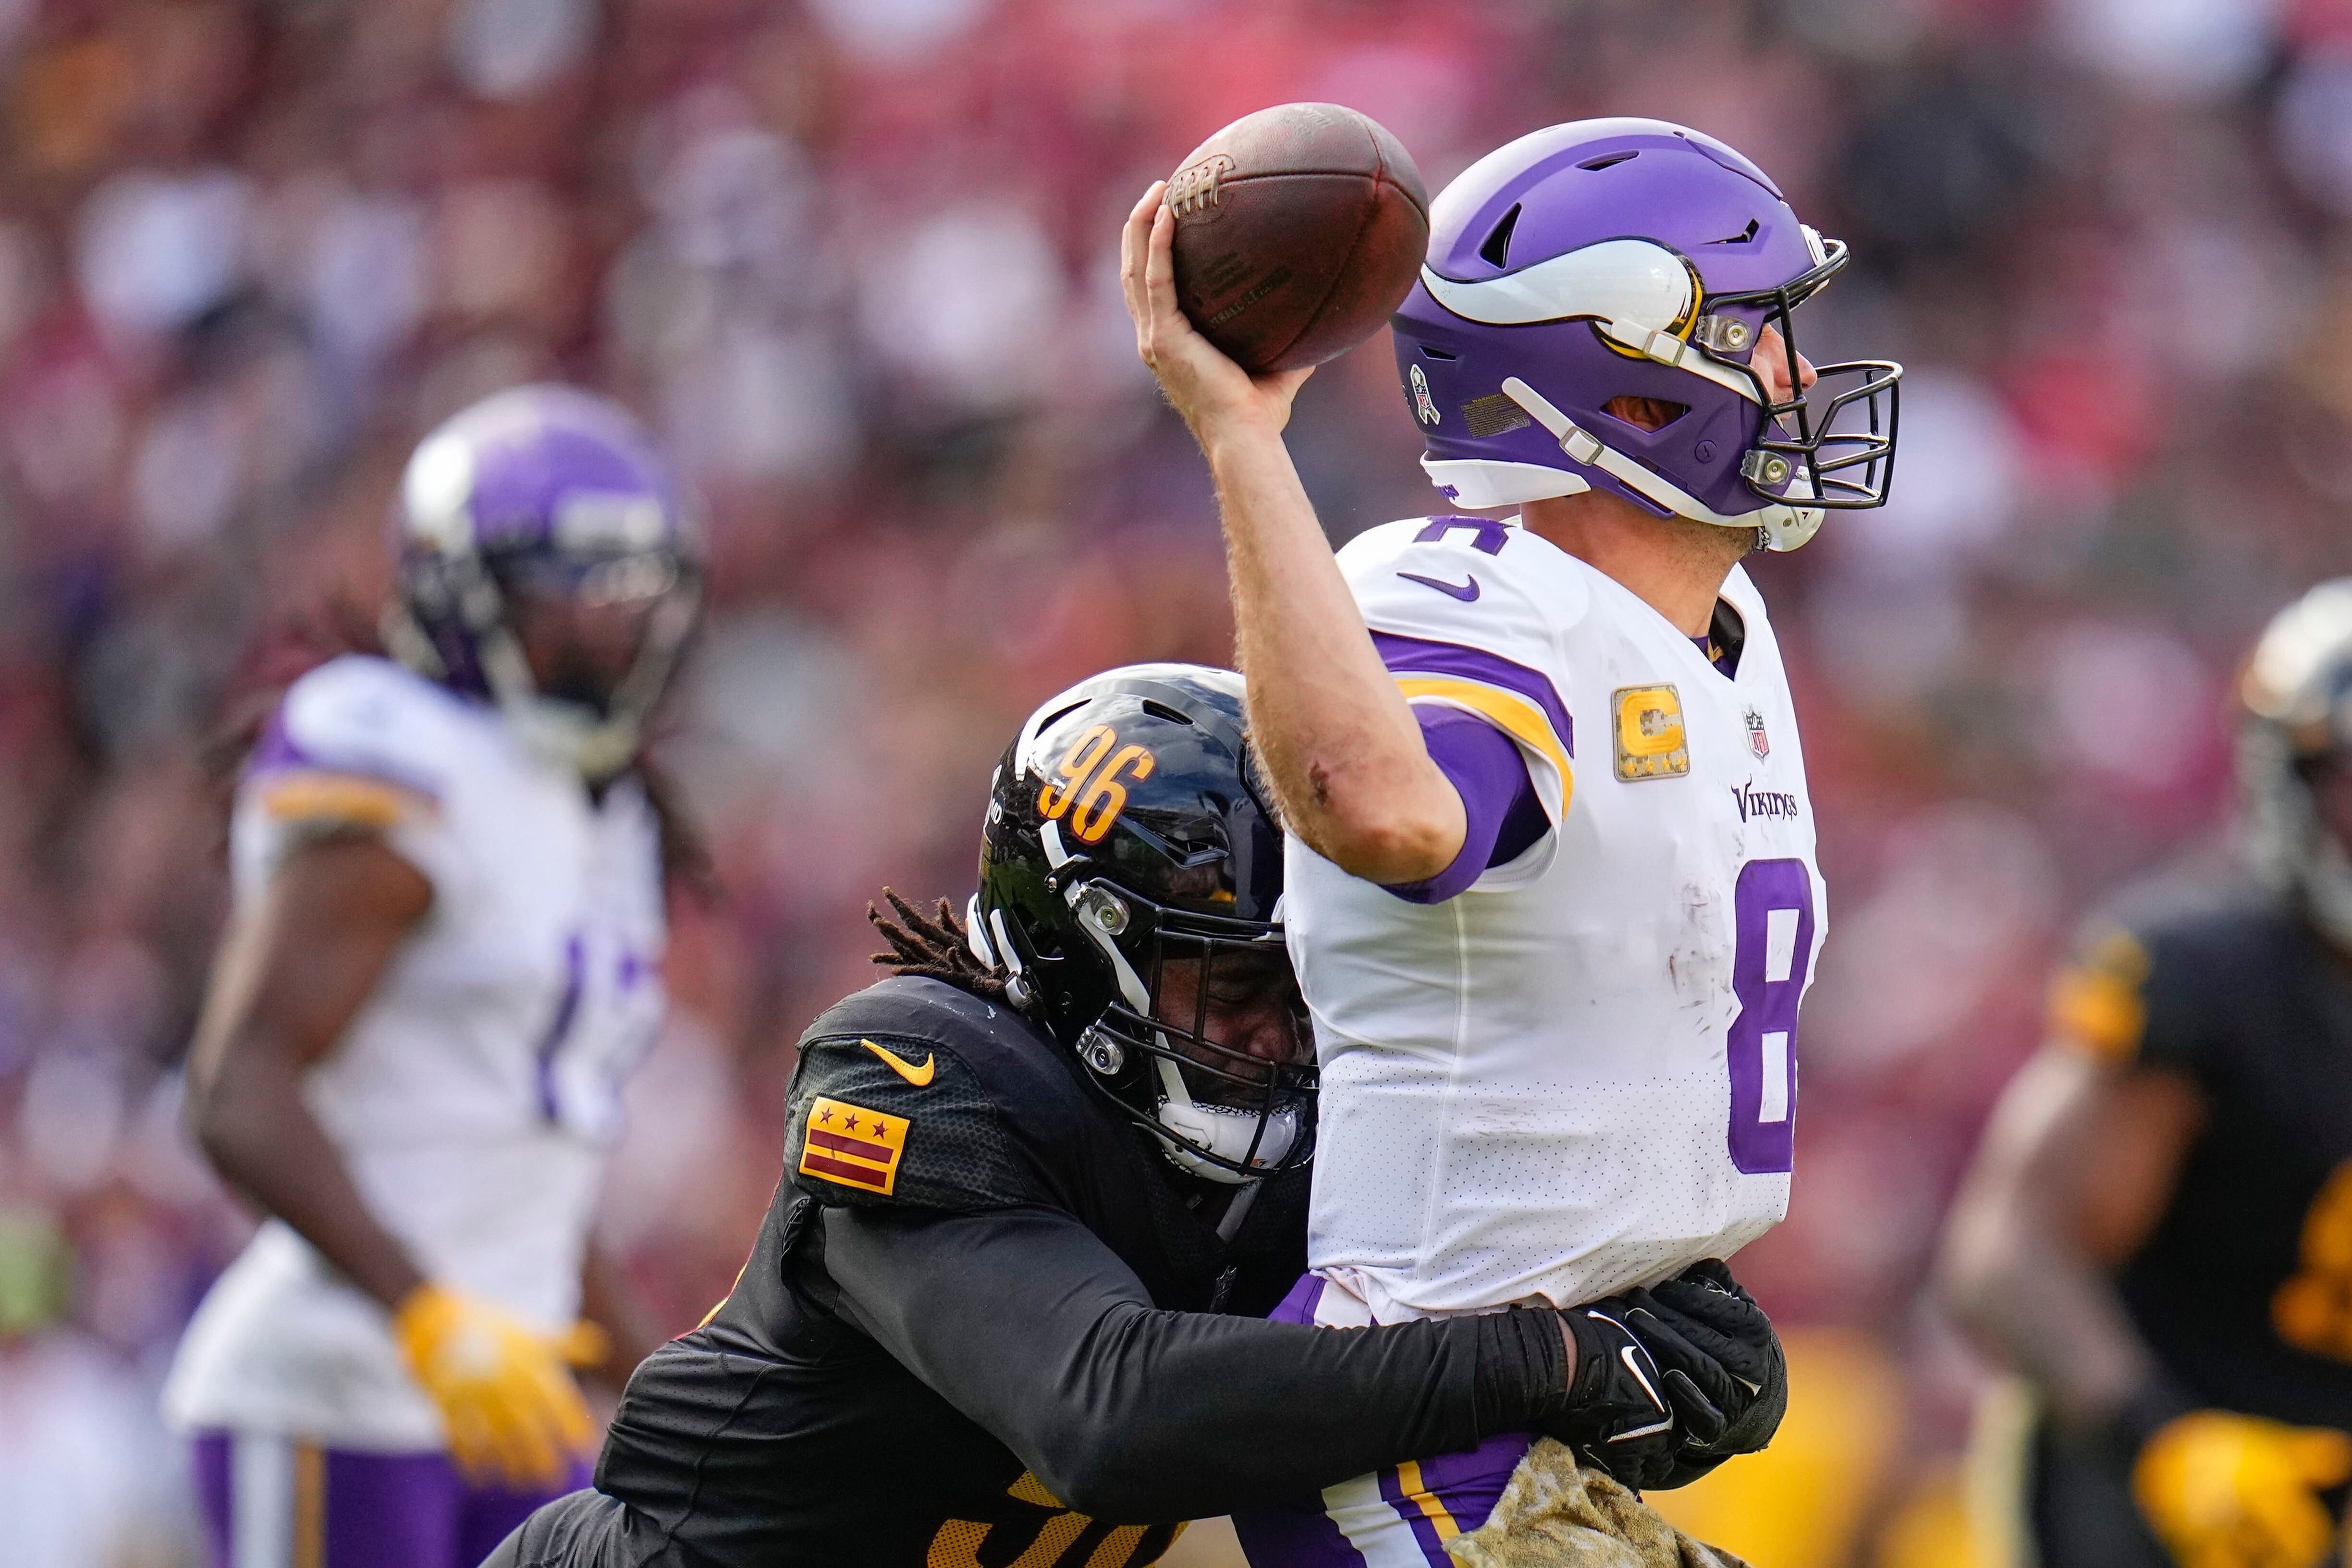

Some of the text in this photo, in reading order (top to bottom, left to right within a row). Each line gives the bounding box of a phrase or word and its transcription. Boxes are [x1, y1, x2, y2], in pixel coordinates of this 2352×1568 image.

[1620, 690, 1683, 757] C
[1752, 732, 1769, 753] NFL
[1037, 723, 1155, 846] 96
[1728, 858, 1814, 1174] 8
